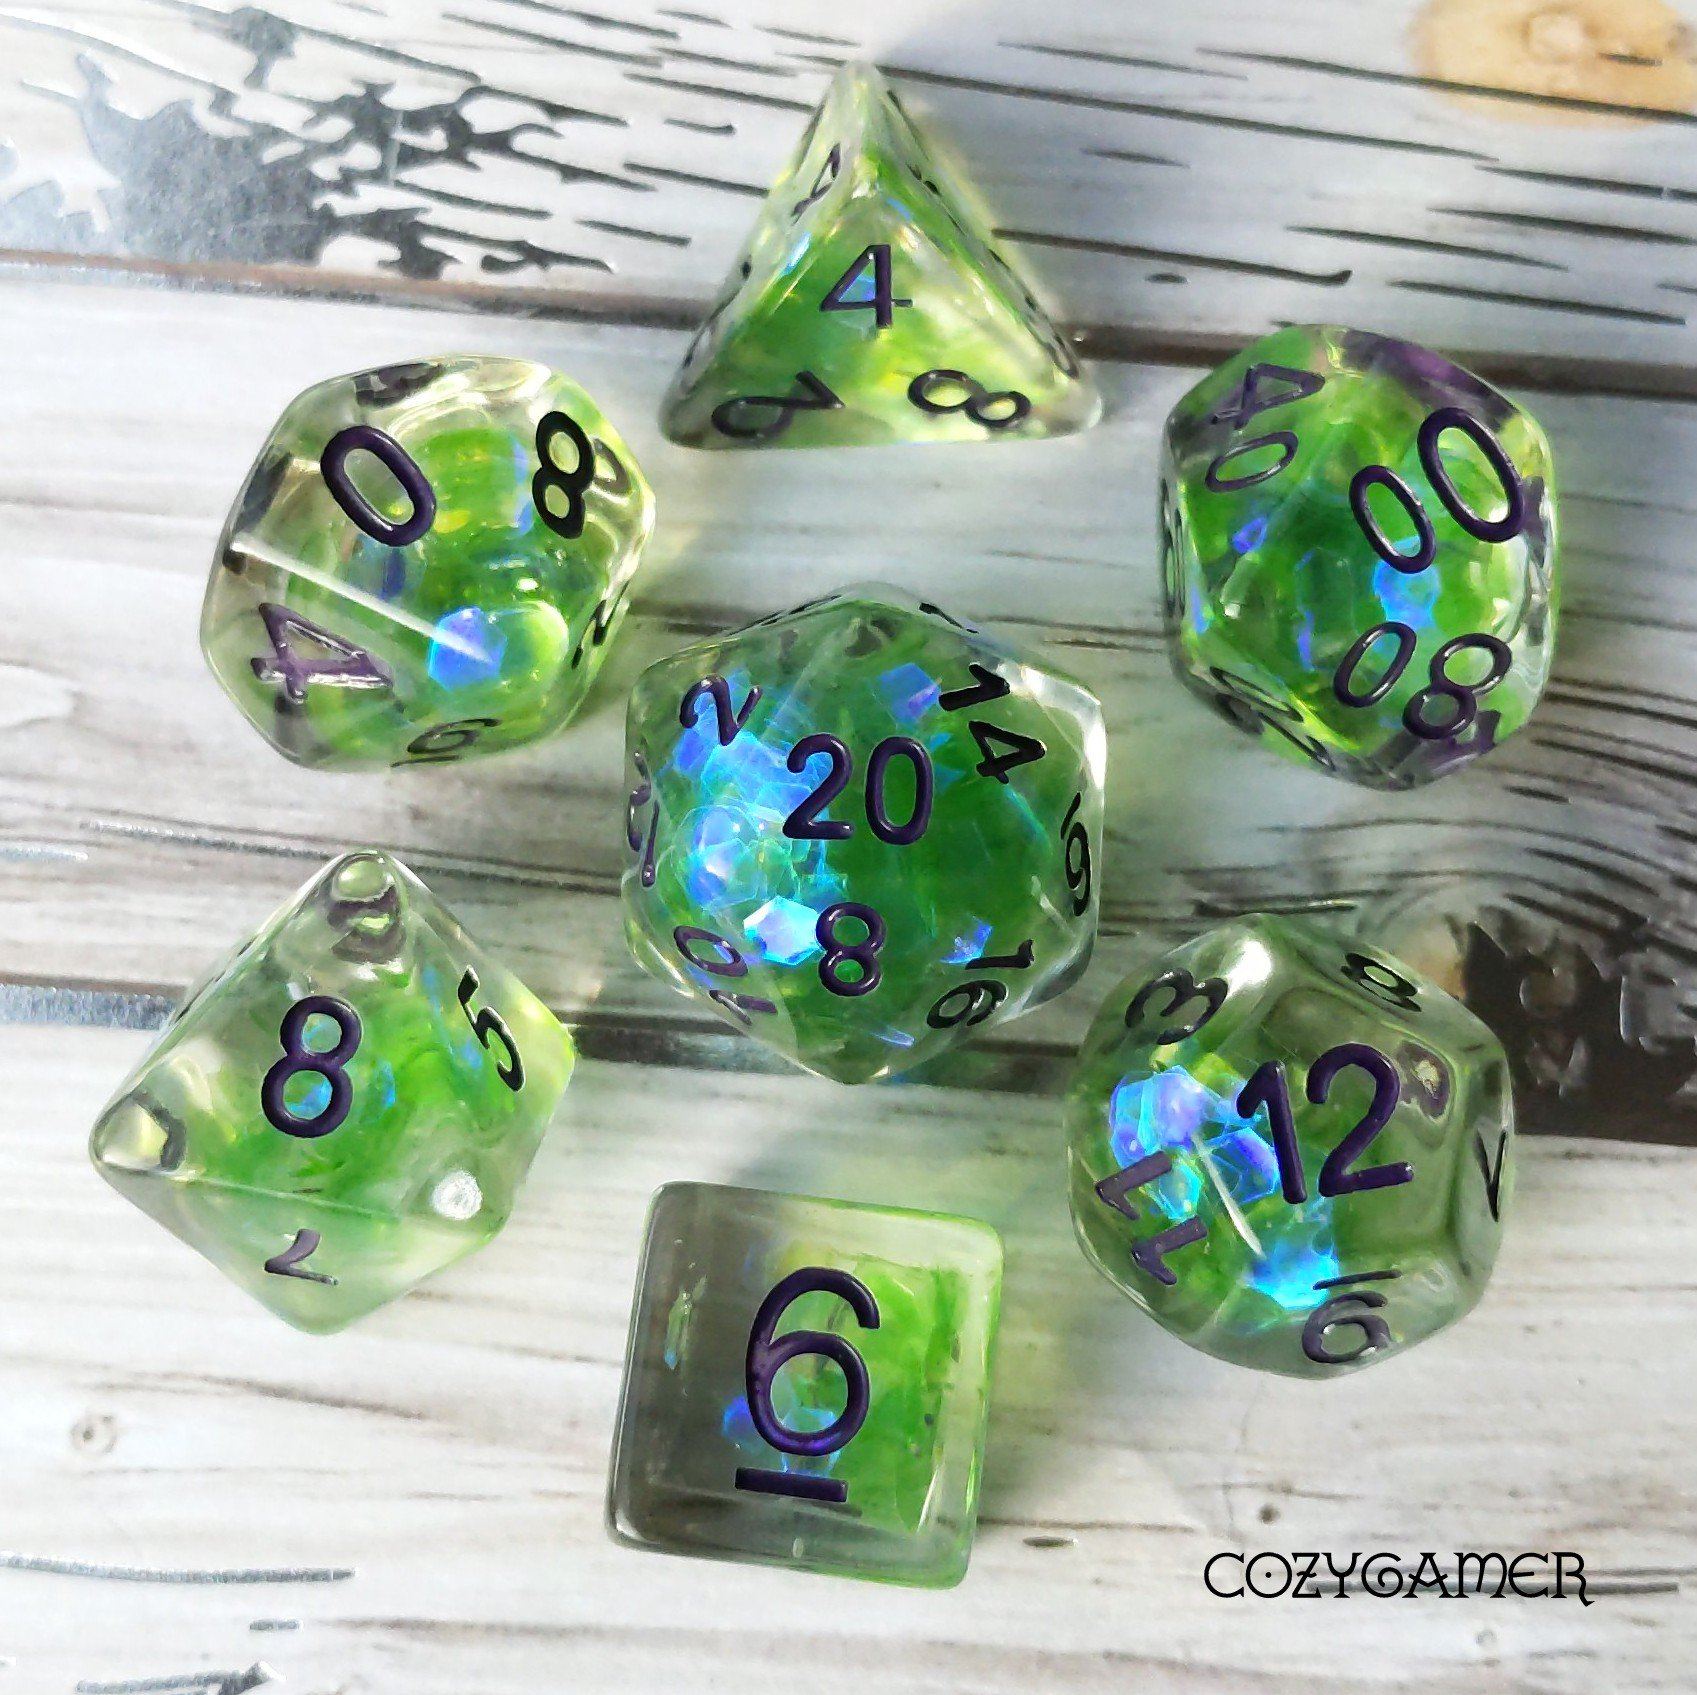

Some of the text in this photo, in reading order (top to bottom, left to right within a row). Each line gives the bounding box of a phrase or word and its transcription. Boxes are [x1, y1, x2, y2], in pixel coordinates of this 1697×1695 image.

[820, 244, 914, 330] 4
[320, 425, 437, 547] 0
[532, 410, 596, 539] 8
[1348, 407, 1525, 574] 00
[250, 602, 394, 704] 4
[679, 673, 763, 747] 2
[1332, 620, 1512, 740] 80
[938, 662, 1047, 785] 14
[782, 733, 934, 846] 20
[815, 901, 887, 997] 8
[925, 938, 1036, 1030] 16
[1124, 967, 1229, 1046] 3
[260, 994, 362, 1138] 8
[456, 964, 526, 1092] 5
[1236, 1042, 1414, 1204] 12
[735, 1266, 881, 1502] 6
